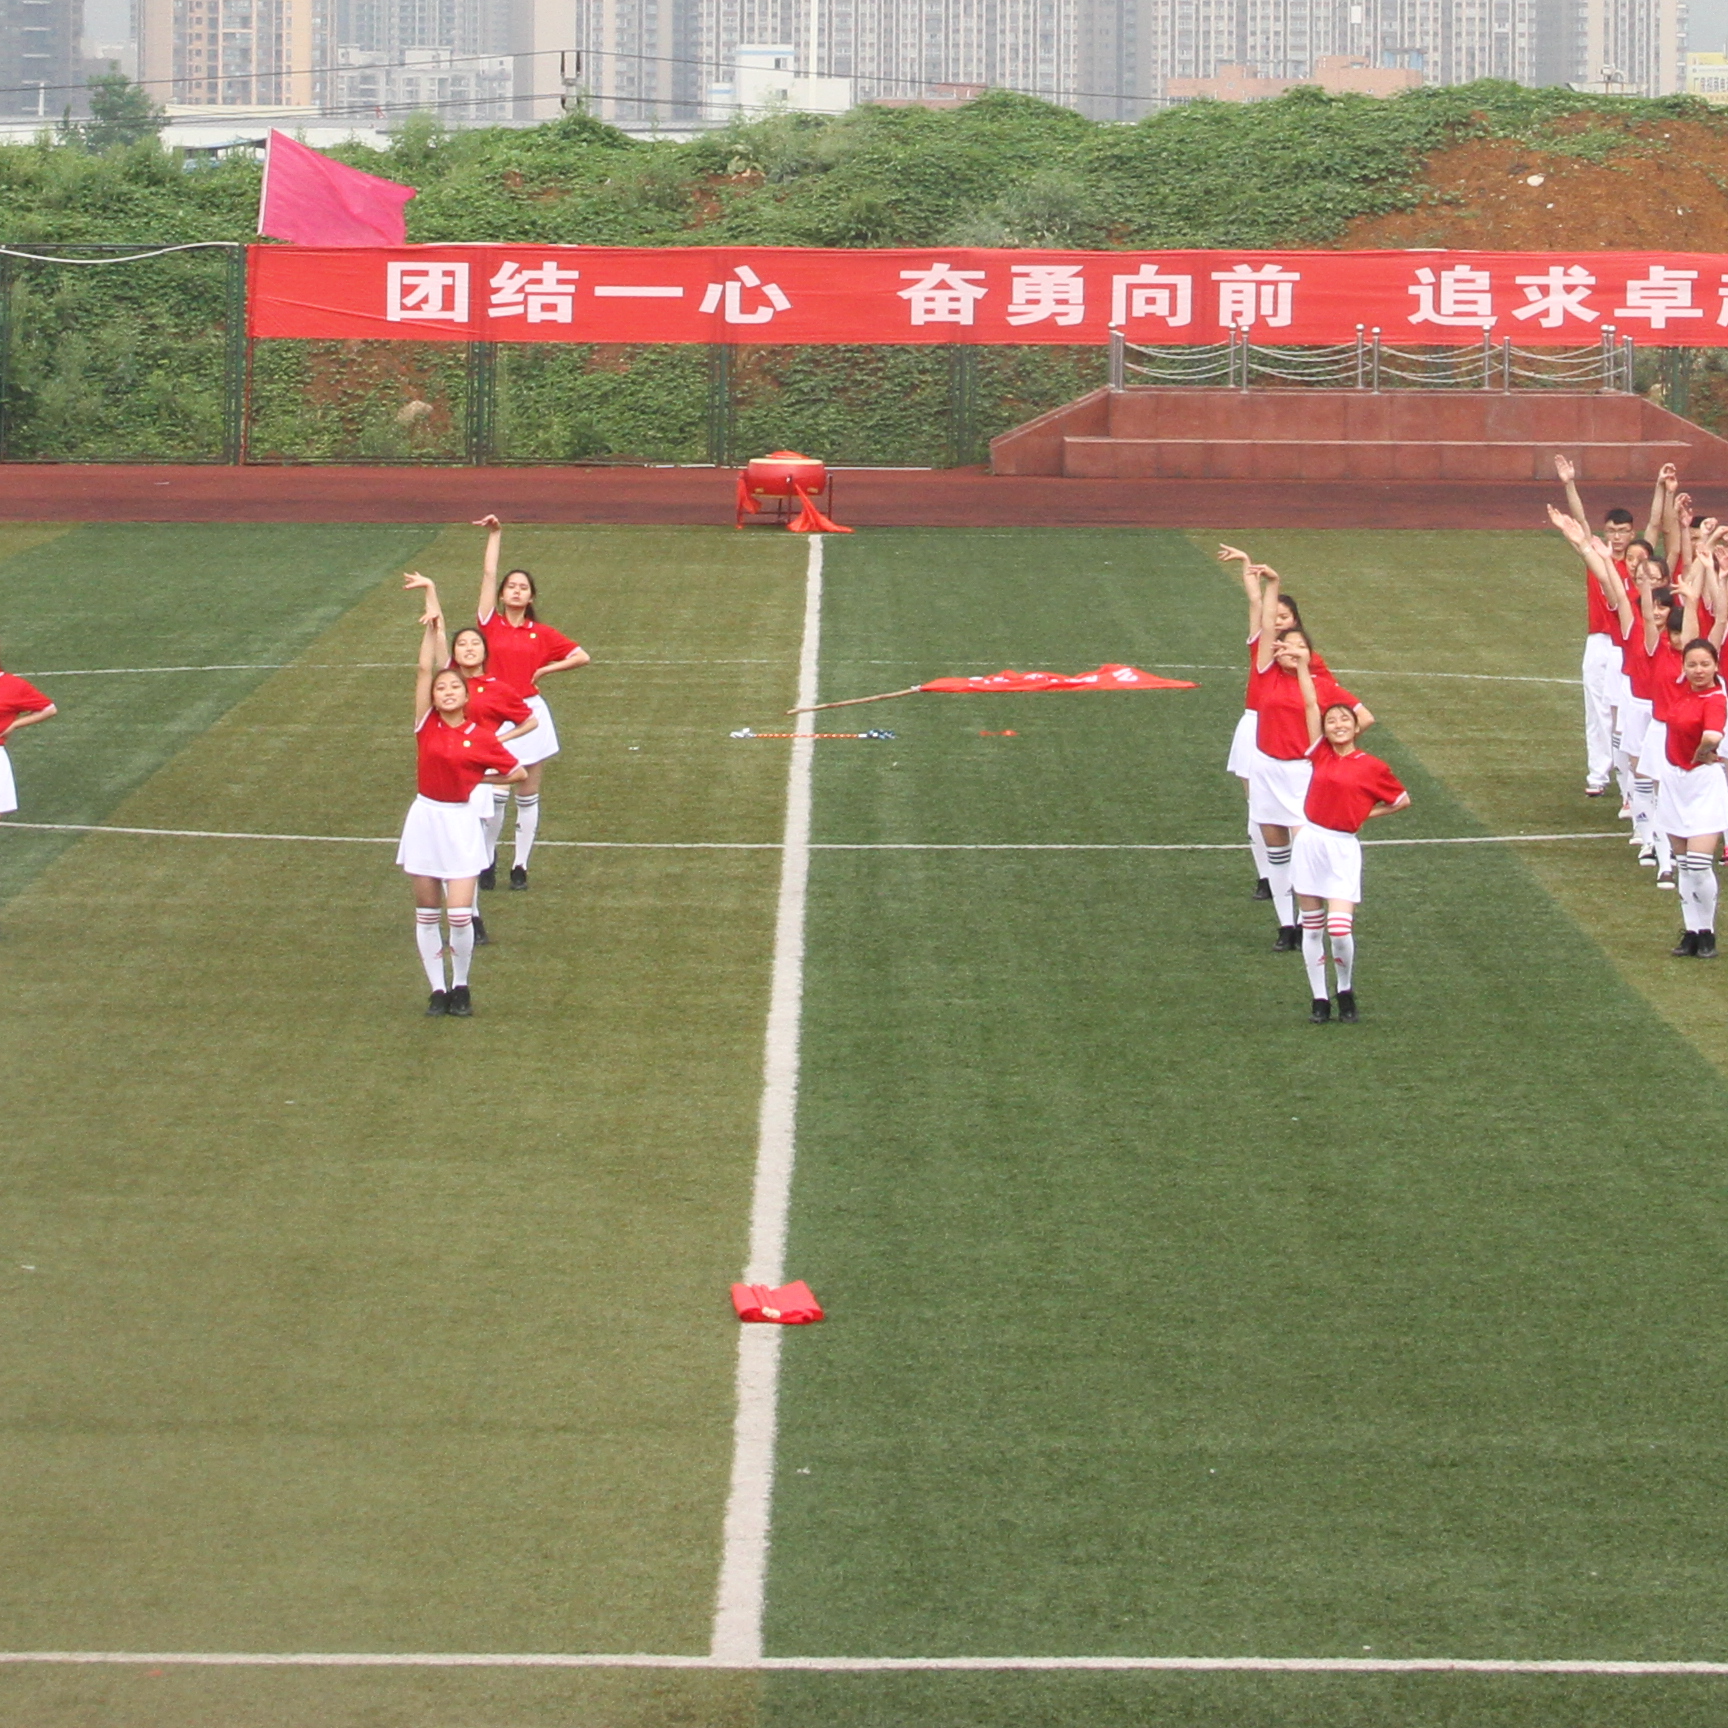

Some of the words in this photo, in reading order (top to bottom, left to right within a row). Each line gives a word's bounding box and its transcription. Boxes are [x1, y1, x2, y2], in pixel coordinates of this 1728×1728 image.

[386, 261, 792, 324] 团结一心
[896, 263, 1301, 328] 奋勇向前
